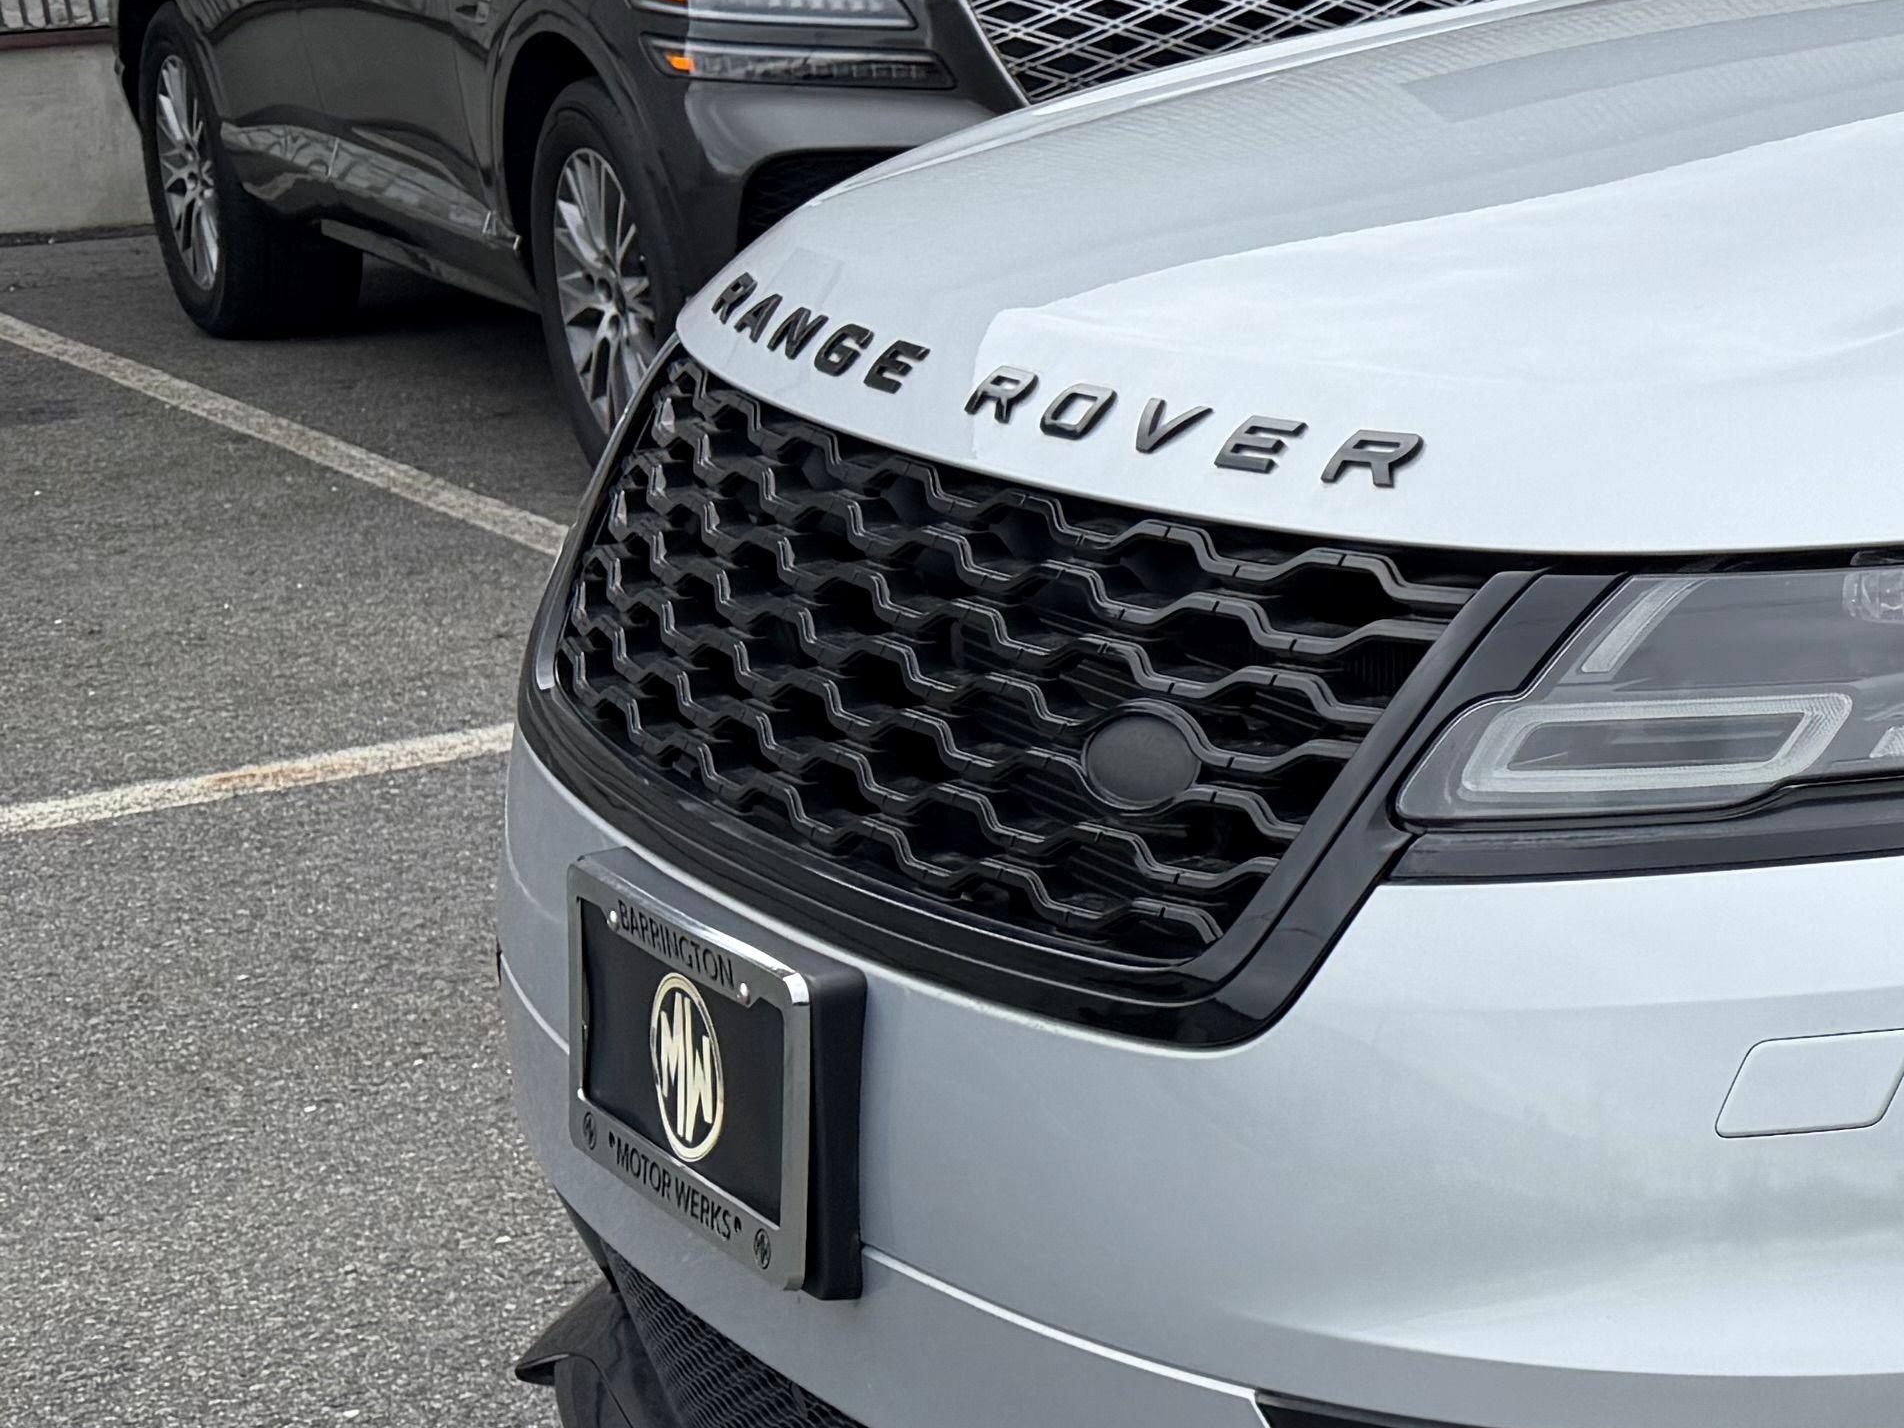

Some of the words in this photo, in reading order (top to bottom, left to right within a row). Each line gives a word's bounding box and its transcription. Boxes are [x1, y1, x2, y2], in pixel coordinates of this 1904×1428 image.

[711, 271, 931, 394] RANGE
[963, 364, 1427, 489] ROVER
[618, 899, 735, 988] BARRINGTON
[615, 1136, 672, 1202] MOTOR
[674, 1175, 731, 1241] WERKS
